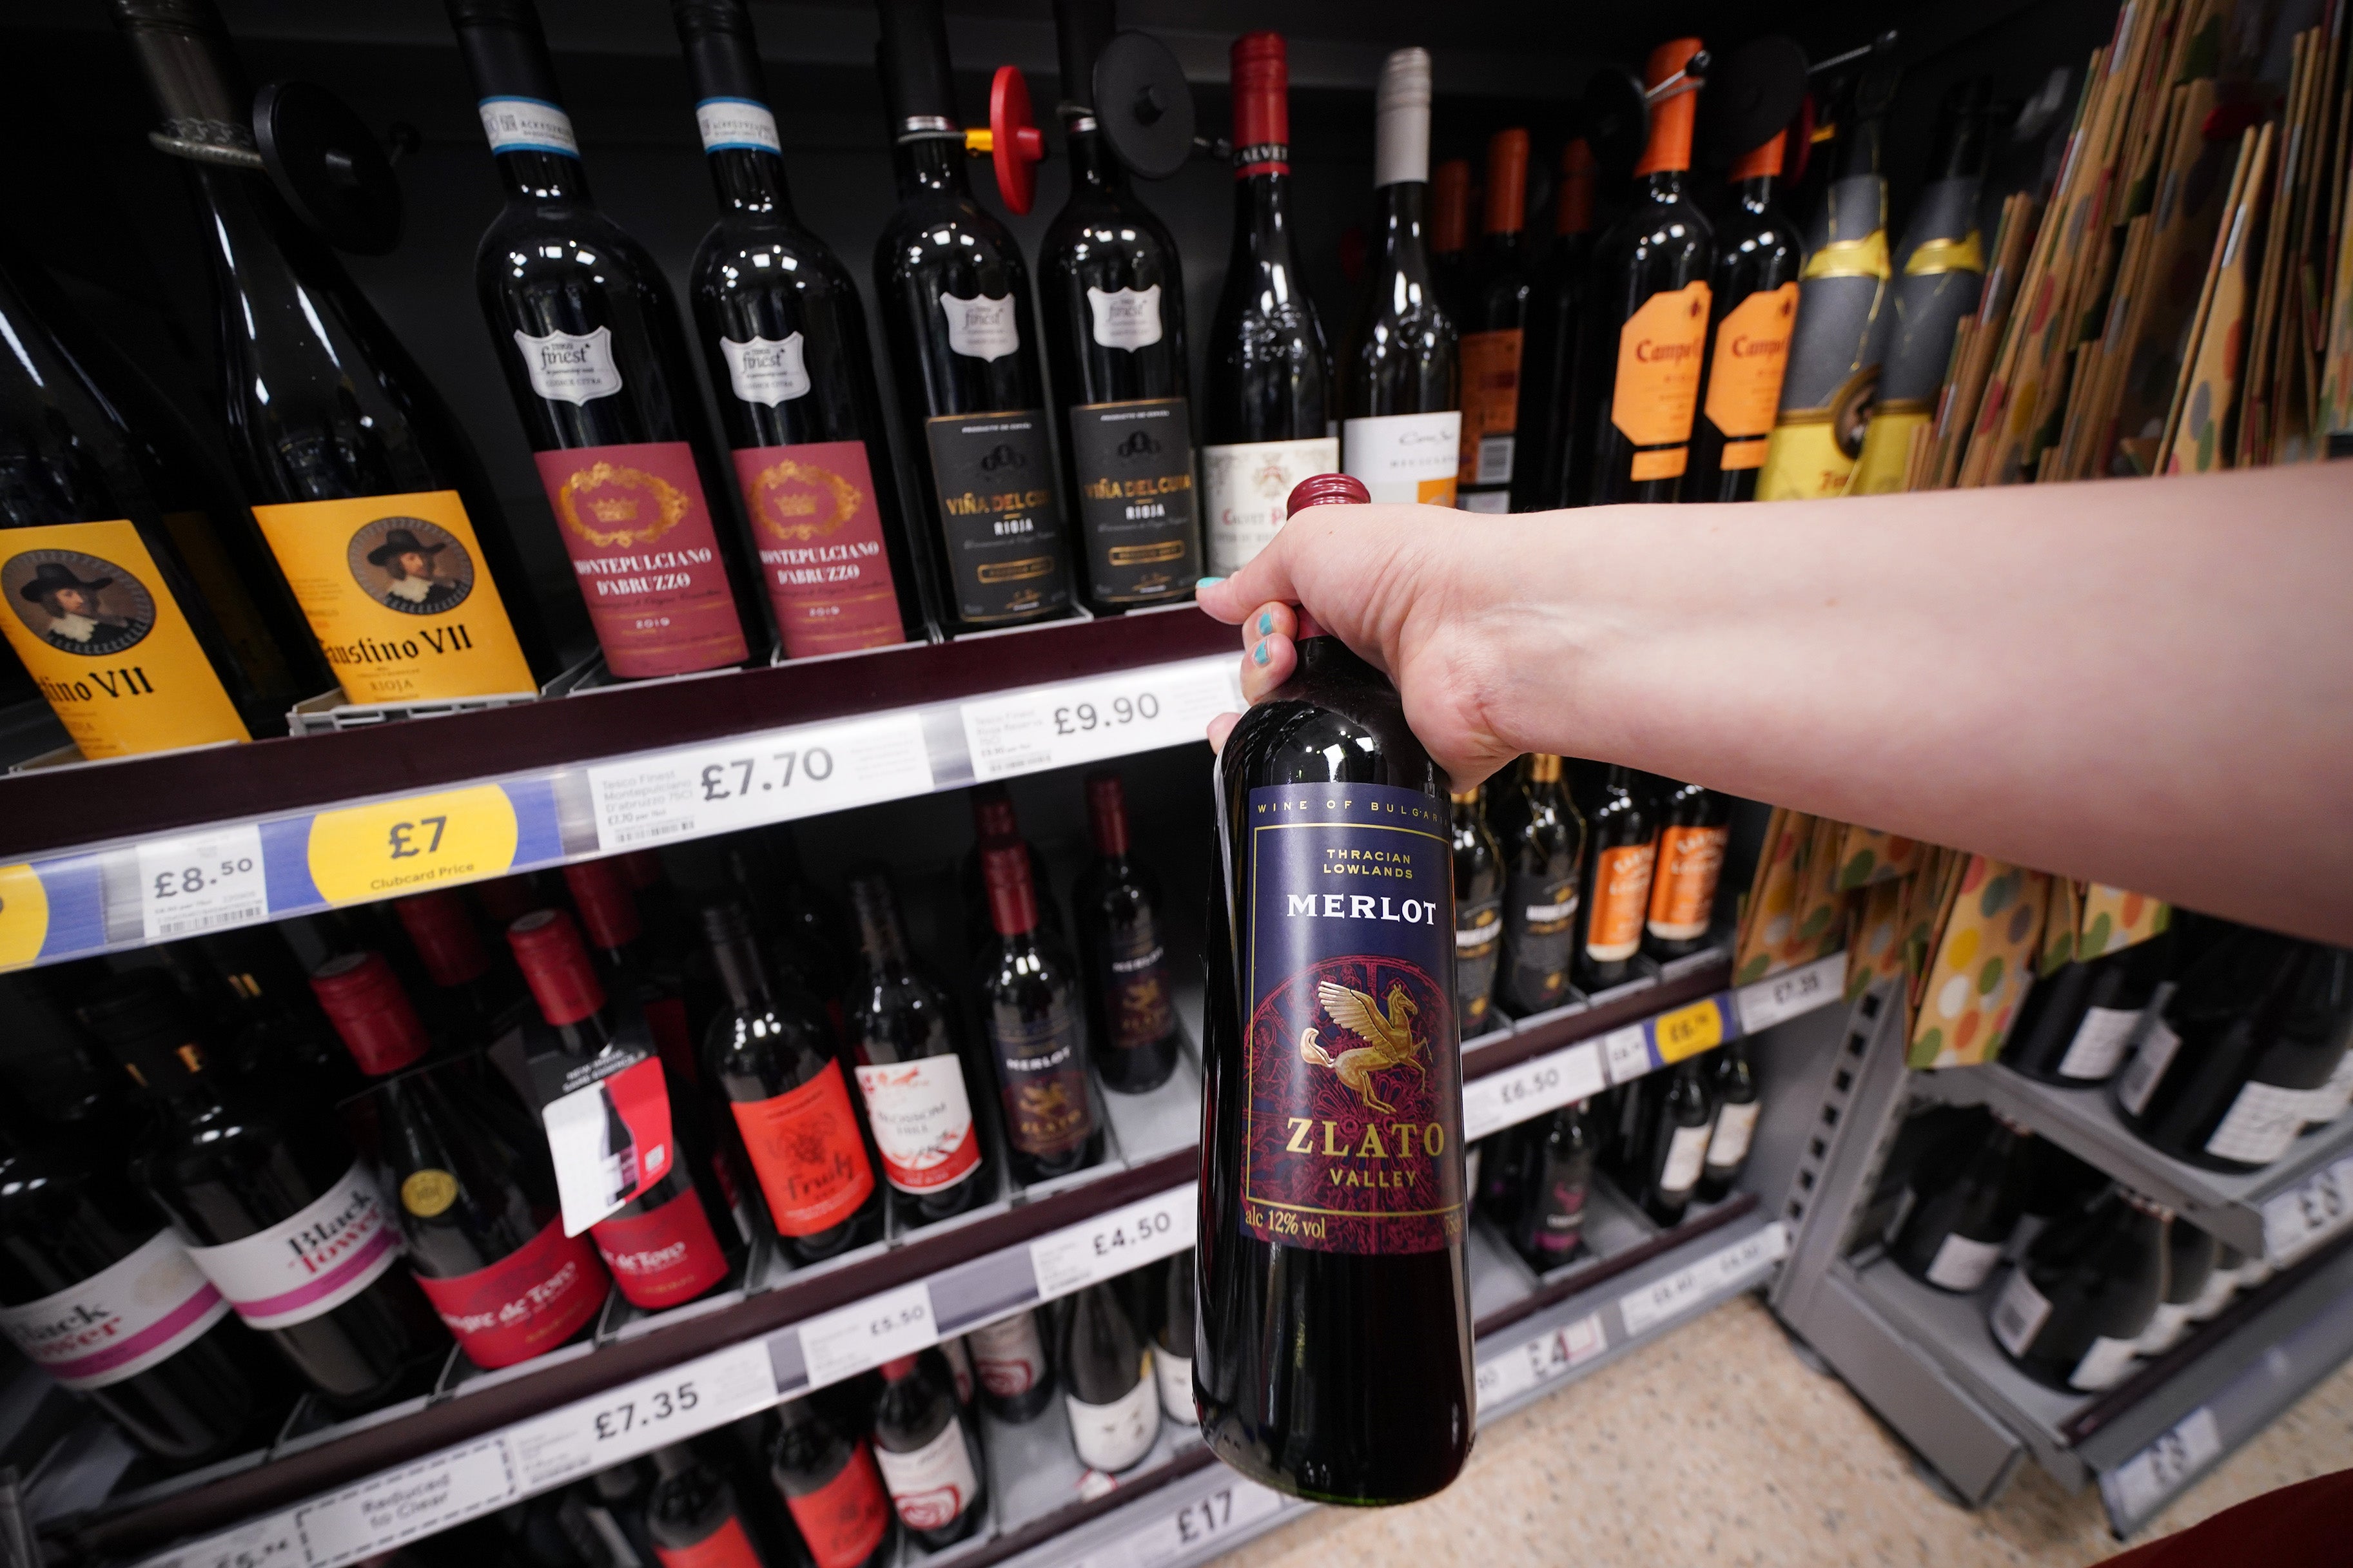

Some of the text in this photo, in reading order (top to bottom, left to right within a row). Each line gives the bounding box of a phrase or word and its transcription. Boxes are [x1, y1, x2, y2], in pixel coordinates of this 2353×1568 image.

[540, 345, 587, 373] finest
[574, 547, 712, 576] ONTEPULCIANO
[759, 540, 880, 565] ONTEPULCIANO
[419, 624, 474, 655] VII
[89, 666, 155, 699] VII
[1053, 693, 1160, 736] £9.90
[602, 769, 676, 791] Tesco Finest
[700, 746, 834, 802] £7.70
[1257, 799, 1450, 829] WINE OF BULGARIA
[388, 815, 448, 859] £7
[1323, 864, 1414, 880] LOWLANDS
[1326, 848, 1411, 865] THRACIAN
[154, 858, 253, 899] £8.50
[370, 862, 474, 892] Clubcard Price
[1286, 893, 1436, 926] MERLOT
[1285, 1117, 1445, 1159] ZLATO
[1329, 1168, 1417, 1188] VALLEY
[288, 1189, 373, 1259] Black
[1093, 1212, 1172, 1257] £4.50
[1245, 1208, 1327, 1240] alc 12% vol
[594, 1382, 699, 1441] £7.35
[1177, 1489, 1234, 1543] £17
